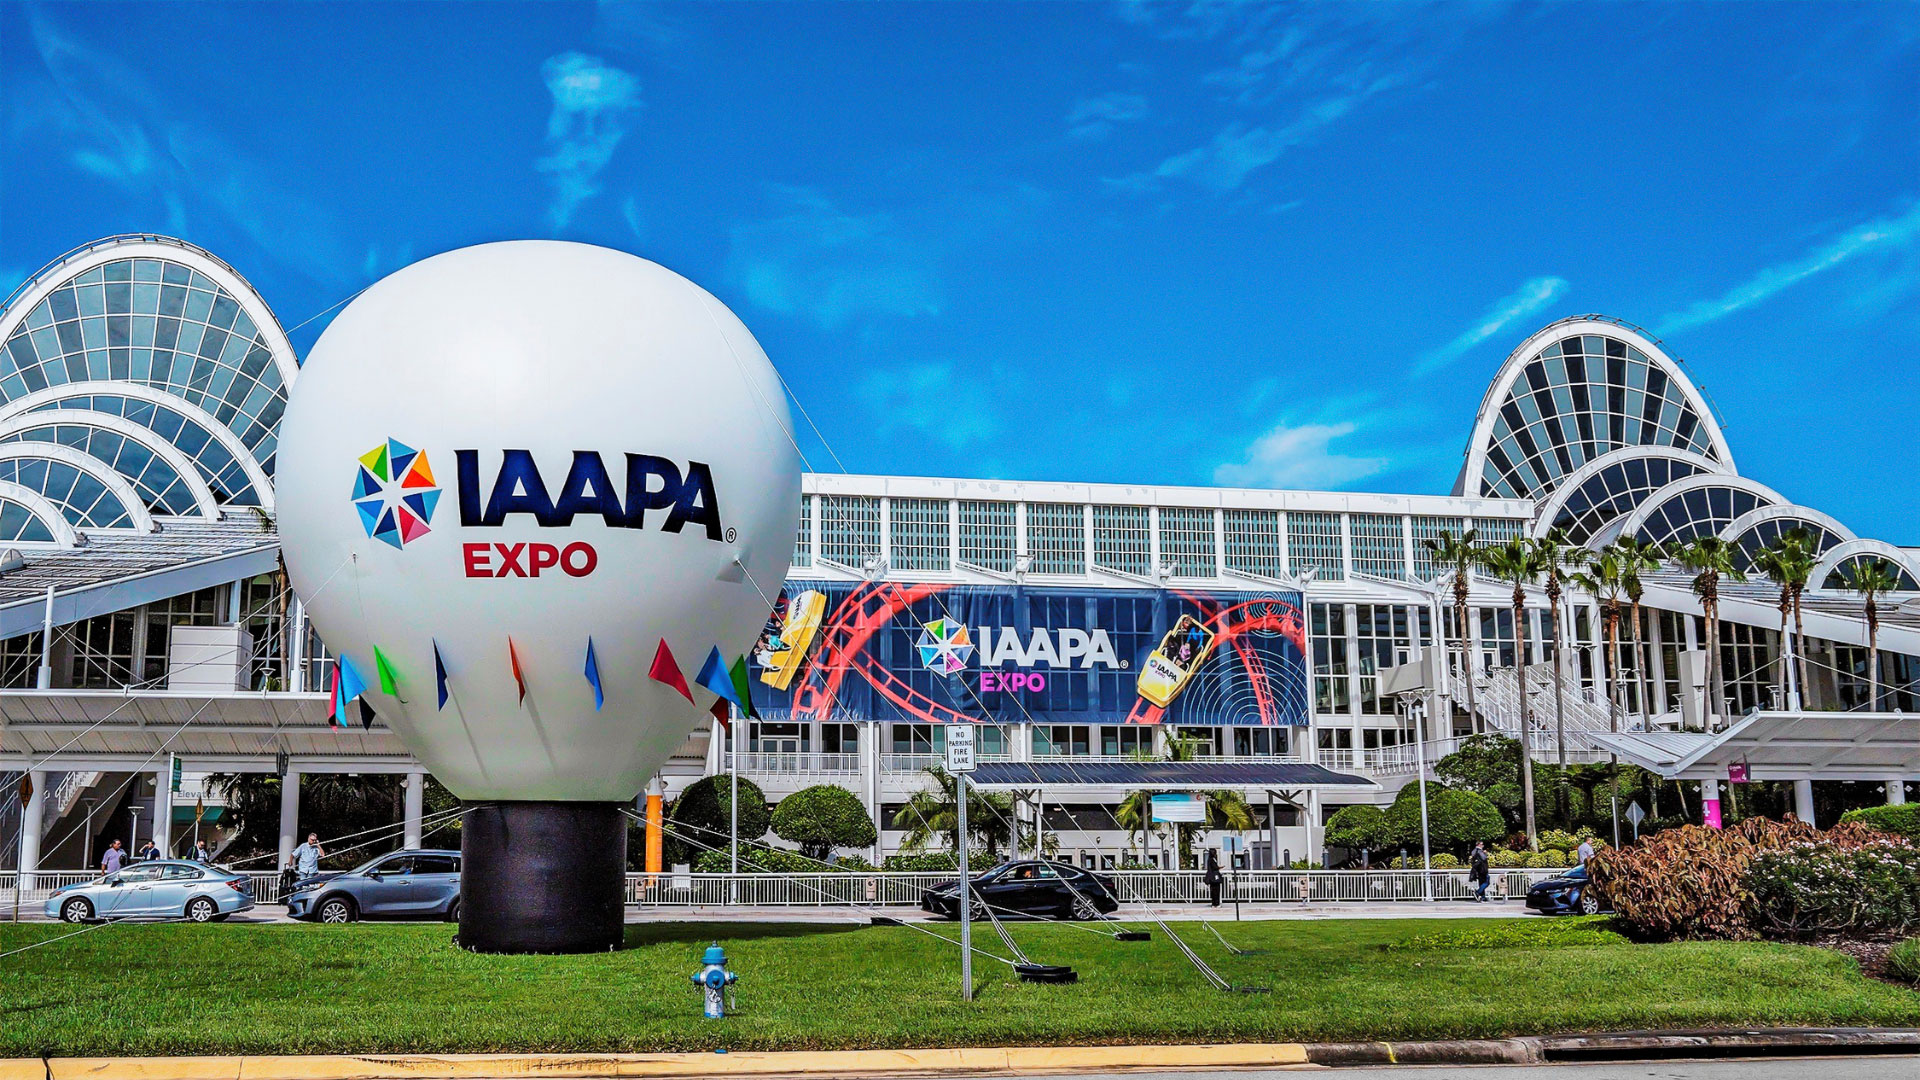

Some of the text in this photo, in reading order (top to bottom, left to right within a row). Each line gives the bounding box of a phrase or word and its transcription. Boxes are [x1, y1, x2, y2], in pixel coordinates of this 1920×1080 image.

[453, 449, 723, 542] IAAPA
[462, 541, 598, 577] EXPO
[978, 626, 1120, 668] IAAPA
[980, 672, 1045, 692] EXPO
[1157, 664, 1176, 682] IAAPA
[1702, 801, 1710, 816] 4
